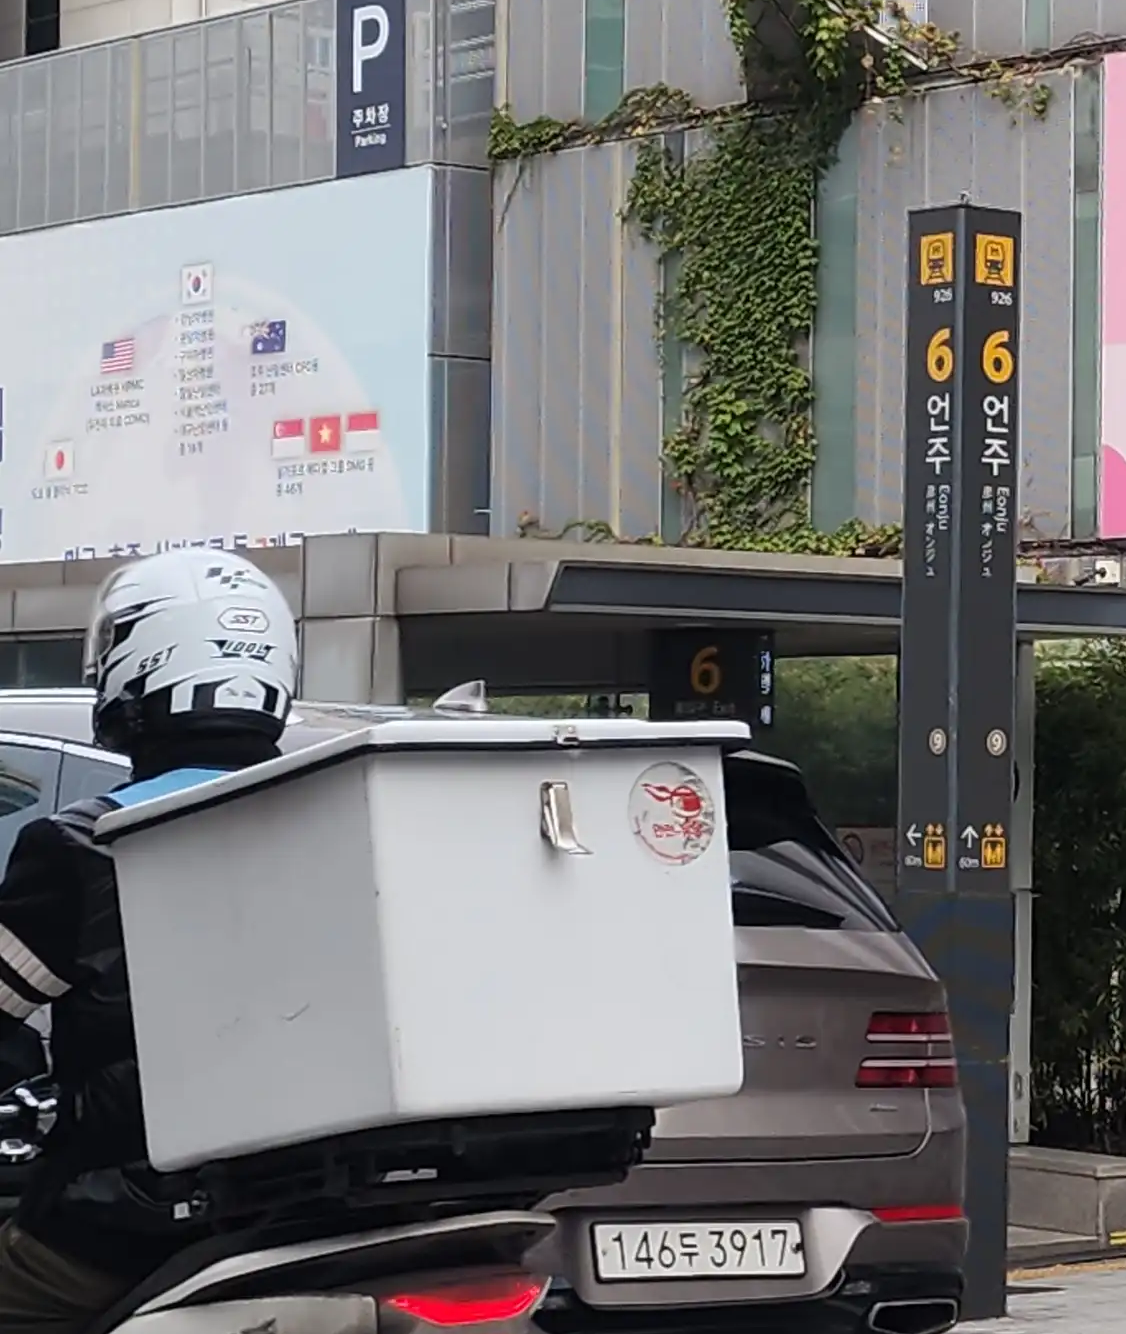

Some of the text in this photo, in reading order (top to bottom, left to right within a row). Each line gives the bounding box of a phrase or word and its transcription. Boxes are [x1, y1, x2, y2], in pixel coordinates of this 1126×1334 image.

[353, 5, 389, 92] P
[352, 103, 389, 128] 주차장
[927, 328, 953, 383] 6
[982, 330, 1014, 384] 6
[925, 393, 952, 475] 언주
[981, 395, 1011, 476] 언주
[993, 486, 1011, 533] Eonju
[691, 646, 720, 694] 6
[612, 1229, 788, 1270] 146두 3917
